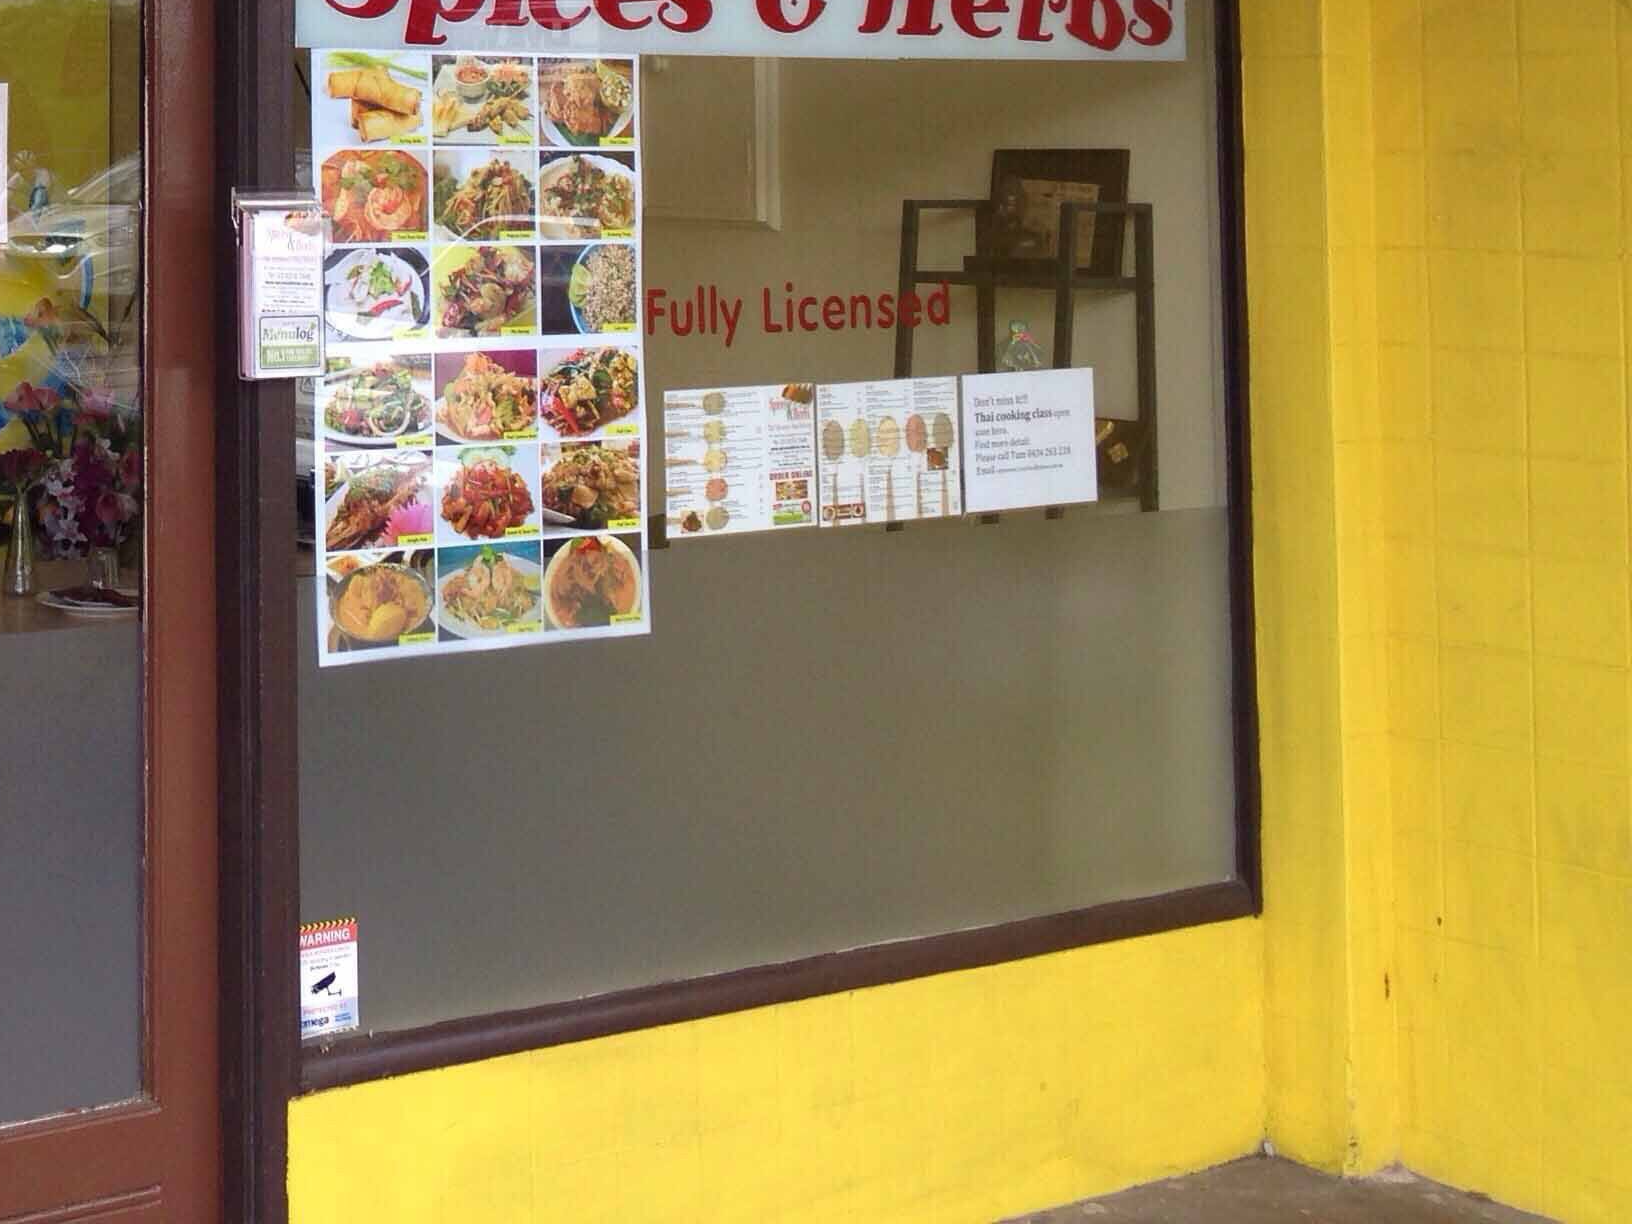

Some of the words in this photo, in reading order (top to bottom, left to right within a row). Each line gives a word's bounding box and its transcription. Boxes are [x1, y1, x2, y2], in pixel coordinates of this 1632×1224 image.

[644, 285, 743, 348] Fully
[761, 279, 952, 334] Licensed
[974, 411, 994, 424] Thai
[996, 409, 1031, 423] cooking
[1031, 407, 1053, 419] class
